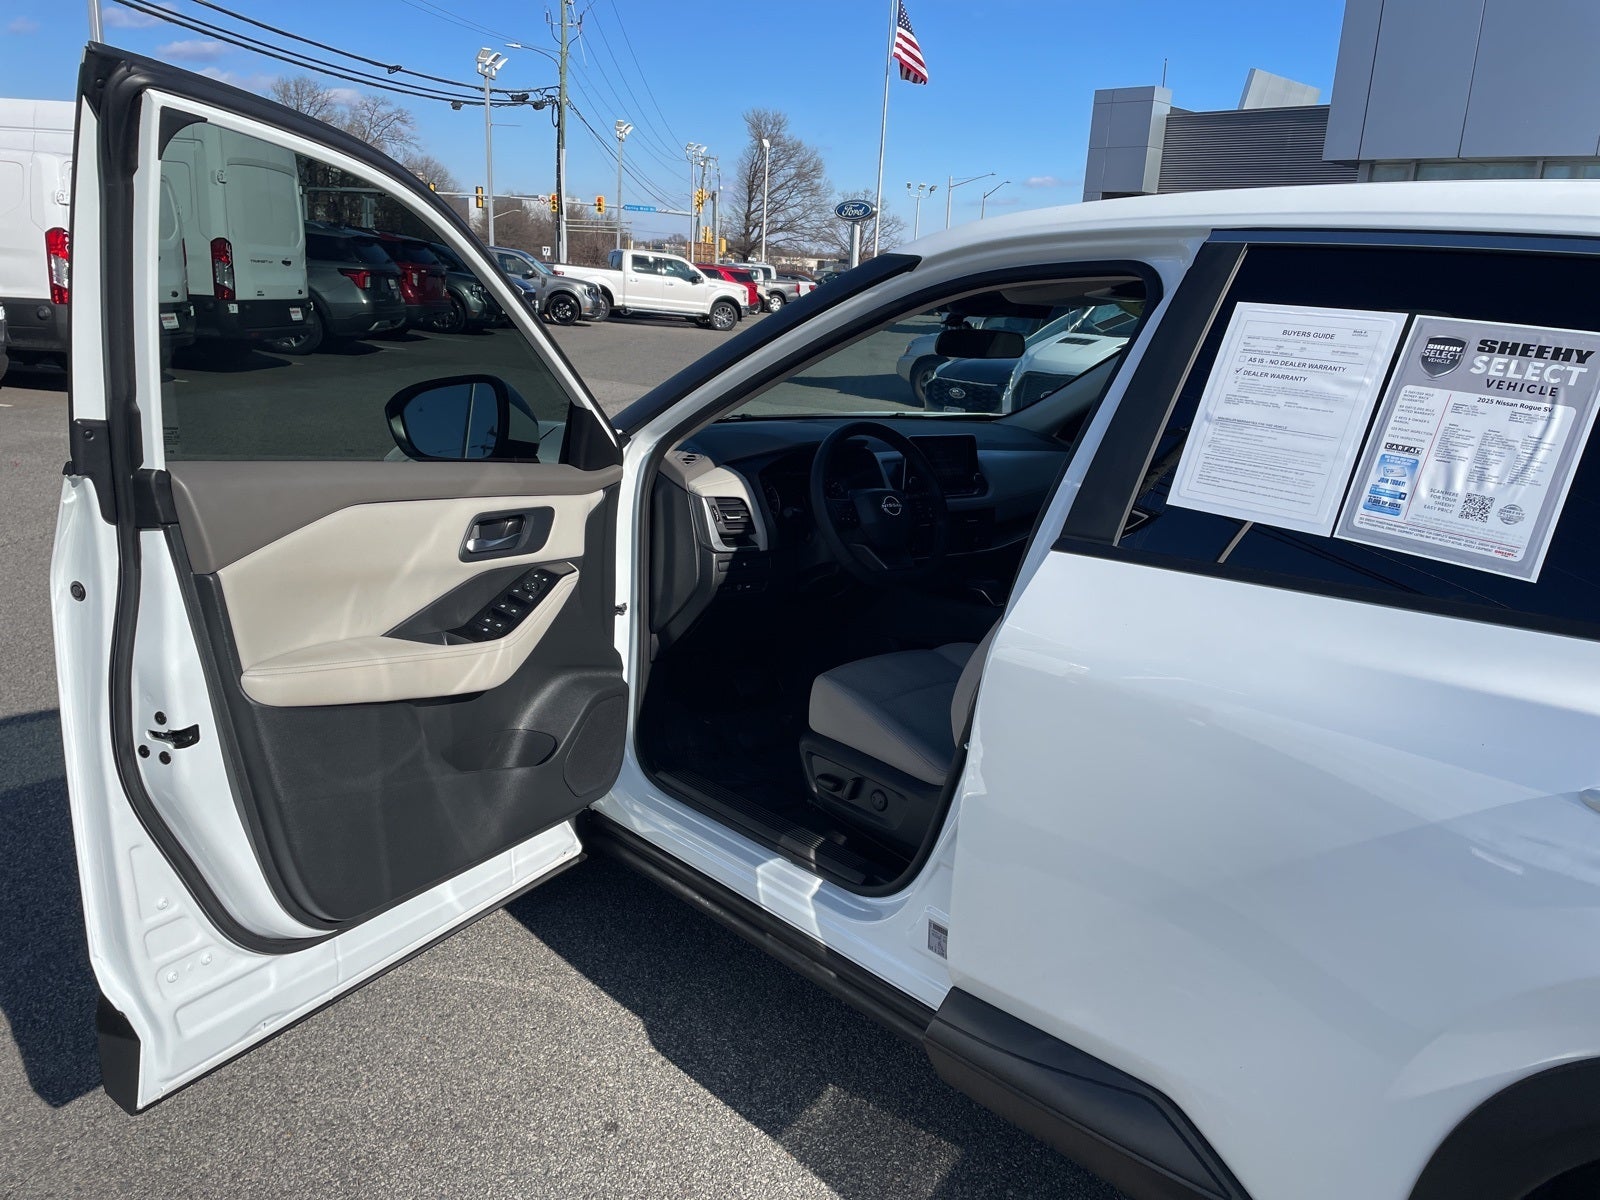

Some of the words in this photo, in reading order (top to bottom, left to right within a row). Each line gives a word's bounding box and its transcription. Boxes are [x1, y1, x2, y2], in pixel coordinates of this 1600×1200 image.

[842, 204, 865, 216] Ford
[1282, 330, 1312, 338] BUYERS
[1312, 332, 1336, 340] GUIDE
[1426, 343, 1462, 352] SHEEHY
[1477, 338, 1596, 364] SHEEHY
[1423, 350, 1463, 360] SELECT
[1280, 360, 1307, 368] DEALER
[1307, 363, 1347, 372] WARRANTY
[1470, 356, 1588, 386] SELECT
[1243, 370, 1269, 378] DEALER
[1270, 373, 1308, 382] WARRANTY
[1486, 378, 1559, 397] VEHICLE
[1495, 400, 1518, 408] Nissan
[1520, 402, 1542, 412] Rogue
[1385, 443, 1423, 454] CARFAX
